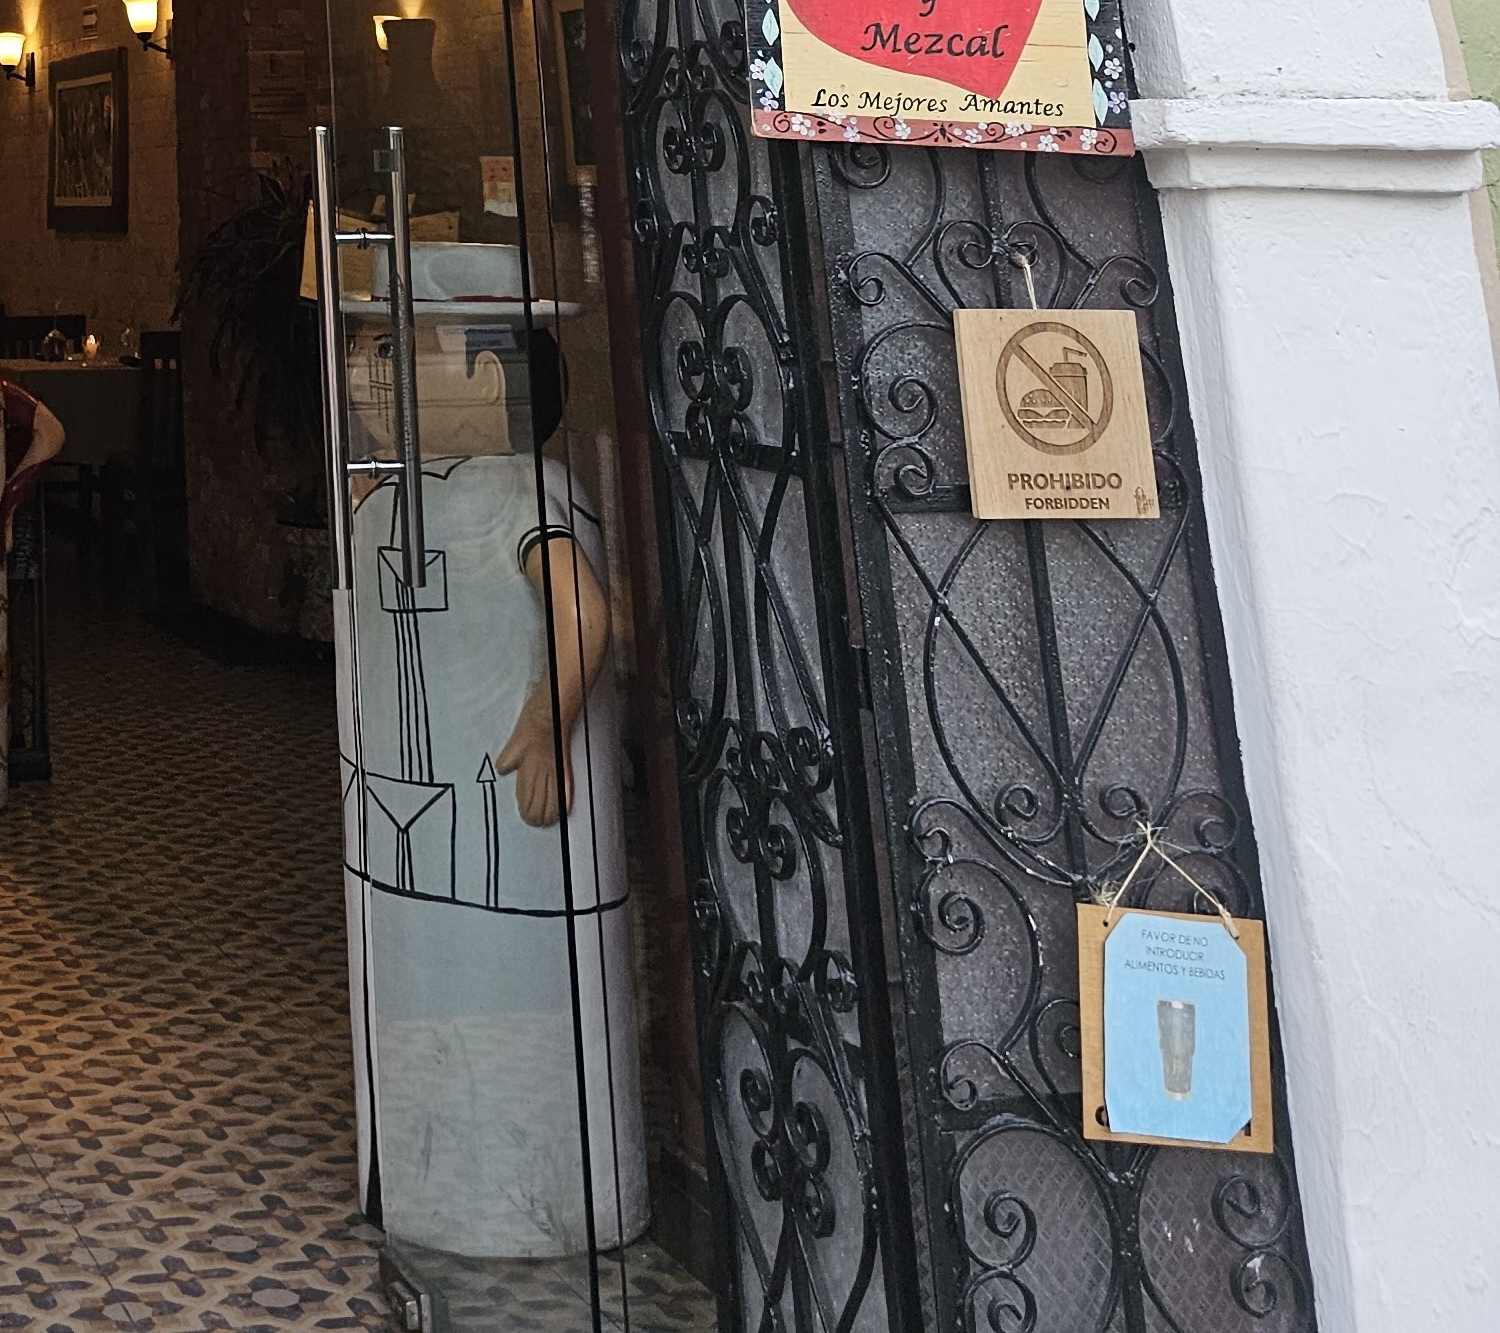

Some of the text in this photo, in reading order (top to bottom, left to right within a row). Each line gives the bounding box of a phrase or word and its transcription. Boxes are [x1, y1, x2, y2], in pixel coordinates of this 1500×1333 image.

[860, 21, 1009, 58] Mezcal
[810, 88, 1065, 118] Los Mejores Amantes
[1008, 473, 1122, 490] PROHIBIDO
[1024, 496, 1111, 510] FORBIDDEN
[1141, 930, 1209, 947] FAVOR DE NO
[1146, 947, 1204, 961] INTRODUCIR
[1123, 959, 1225, 980] ALIMENTOS Y BEBIDAS
